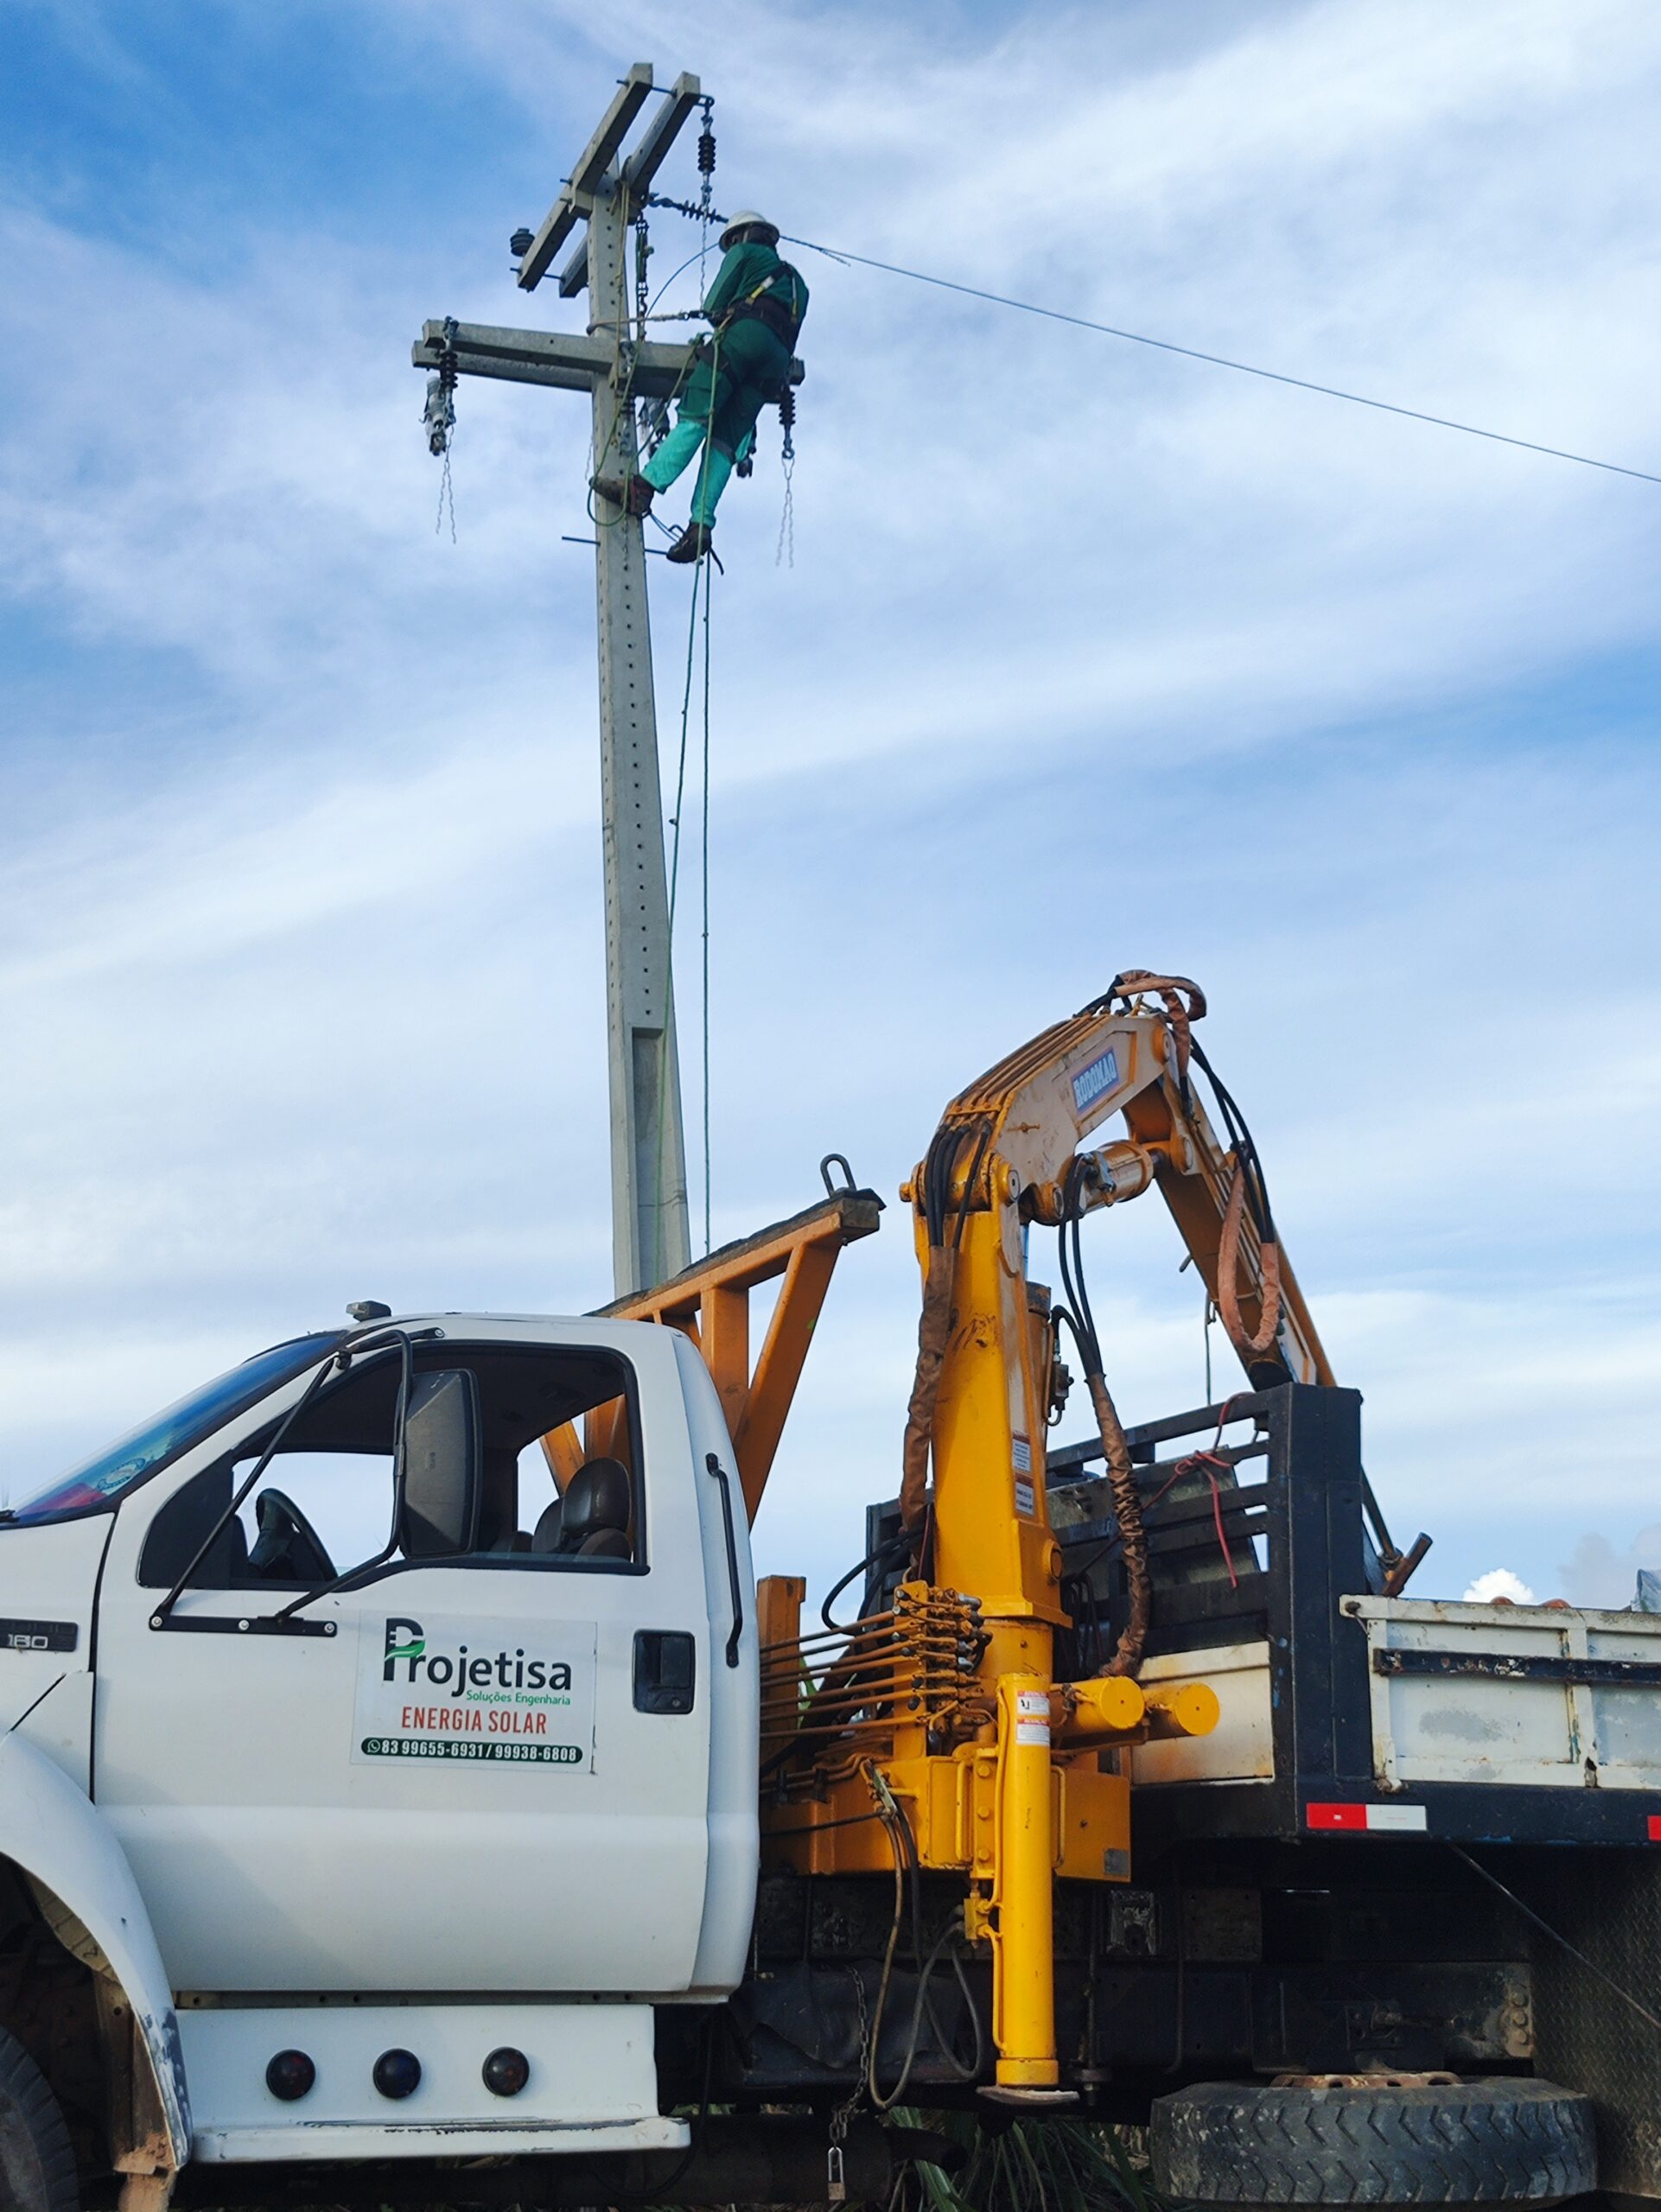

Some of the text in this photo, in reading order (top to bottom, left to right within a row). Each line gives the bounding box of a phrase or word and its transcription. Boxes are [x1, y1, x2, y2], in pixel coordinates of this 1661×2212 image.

[383, 1618, 571, 1698] Projetisa
[466, 1690, 570, 1707] Soluções Engenharia
[401, 1707, 547, 1734] ENERGIA SOLAR
[381, 1739, 398, 1755] 83
